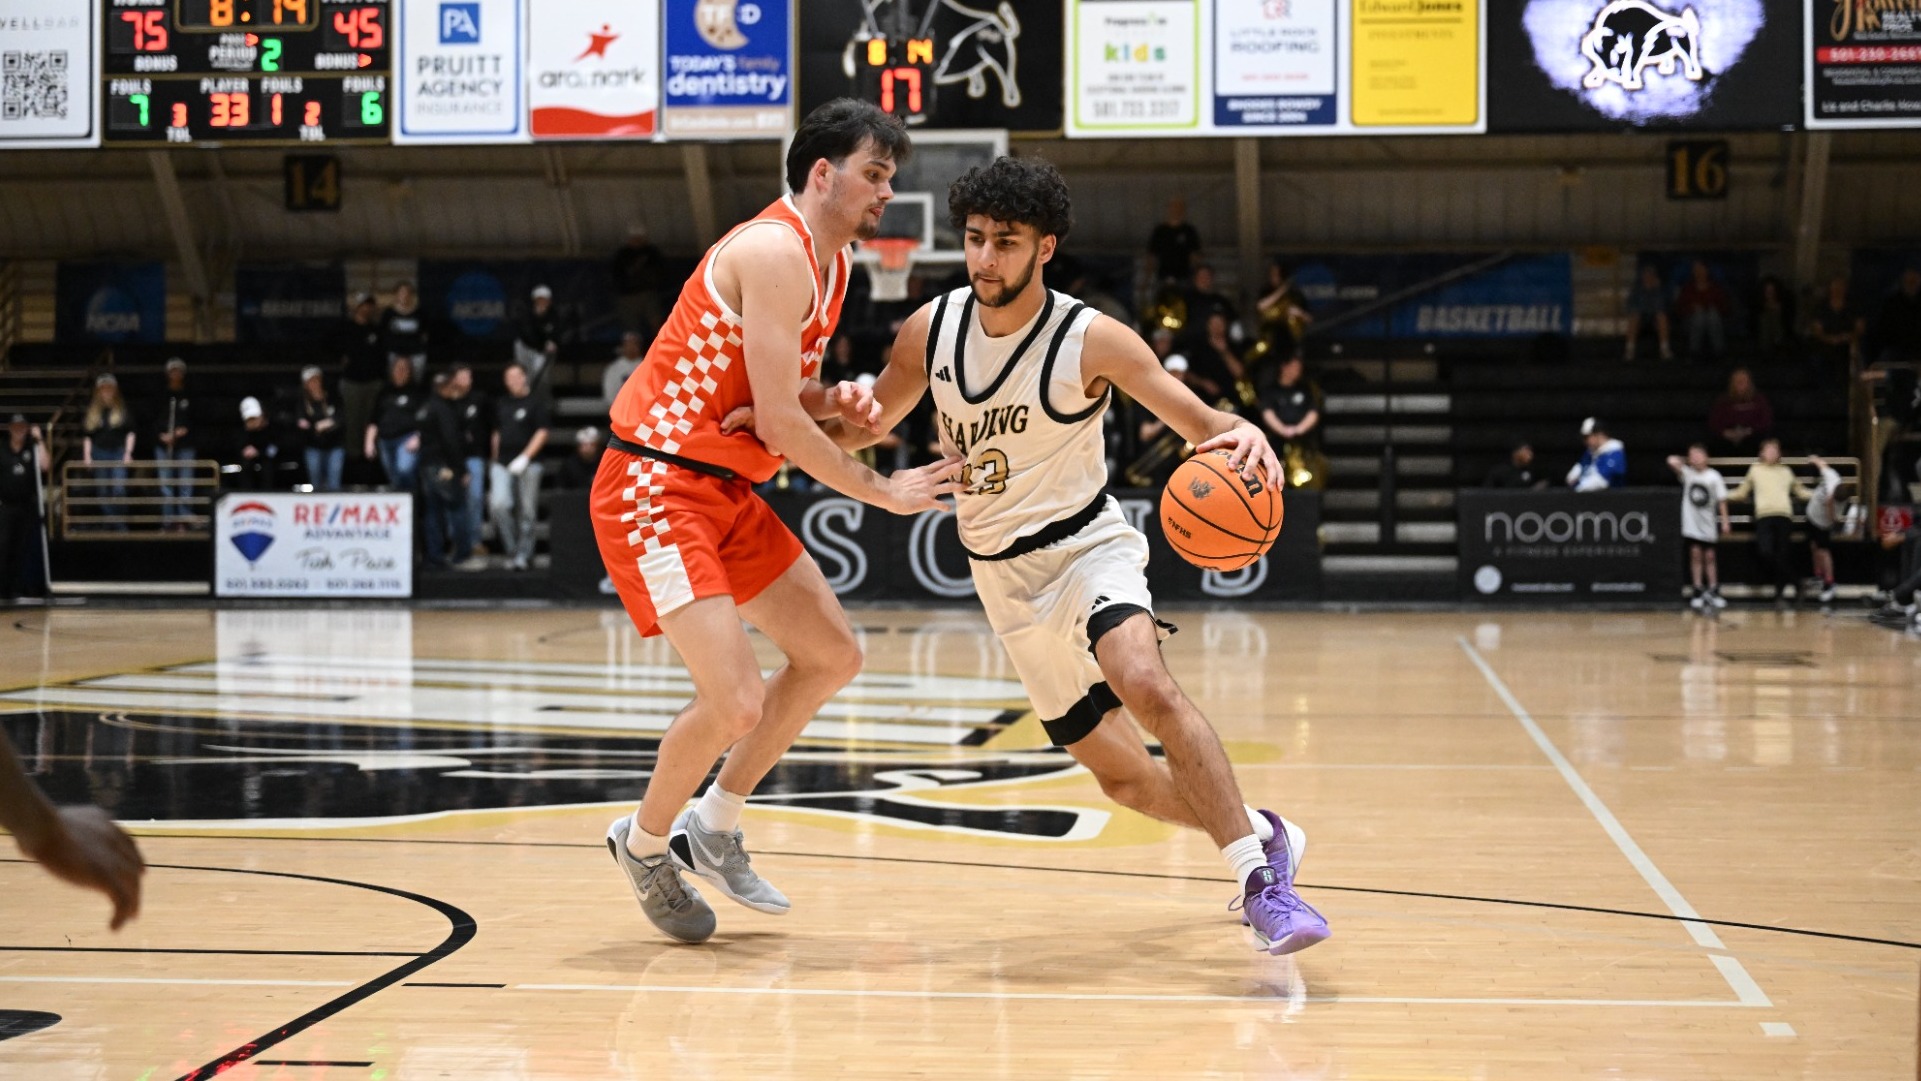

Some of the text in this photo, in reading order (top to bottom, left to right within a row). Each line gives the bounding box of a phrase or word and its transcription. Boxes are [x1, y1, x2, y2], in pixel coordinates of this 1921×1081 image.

[121, 10, 168, 51] 75
[333, 7, 383, 48] 45
[443, 7, 477, 39] PA
[134, 54, 178, 72] BONUS
[261, 38, 282, 72] 2
[314, 52, 358, 70] BONUS
[416, 54, 503, 76] PRUITT
[1104, 41, 1167, 63] kids
[110, 78, 152, 95] FOULS
[200, 76, 303, 94] PLAYER FOULS
[342, 75, 386, 93] FOULS
[416, 78, 504, 98] AGENCY
[667, 72, 787, 101] dentistry
[881, 67, 922, 113] 17
[129, 93, 150, 126] 7
[171, 102, 187, 127] 3
[209, 92, 250, 127] 33
[271, 92, 283, 126] 1
[304, 101, 321, 126] 2
[361, 91, 384, 125] 6
[1673, 147, 1726, 197] 16
[1415, 304, 1563, 333] BASKETBALL
[294, 503, 401, 525] RE/MAX
[304, 528, 392, 540] ADVANTAGE
